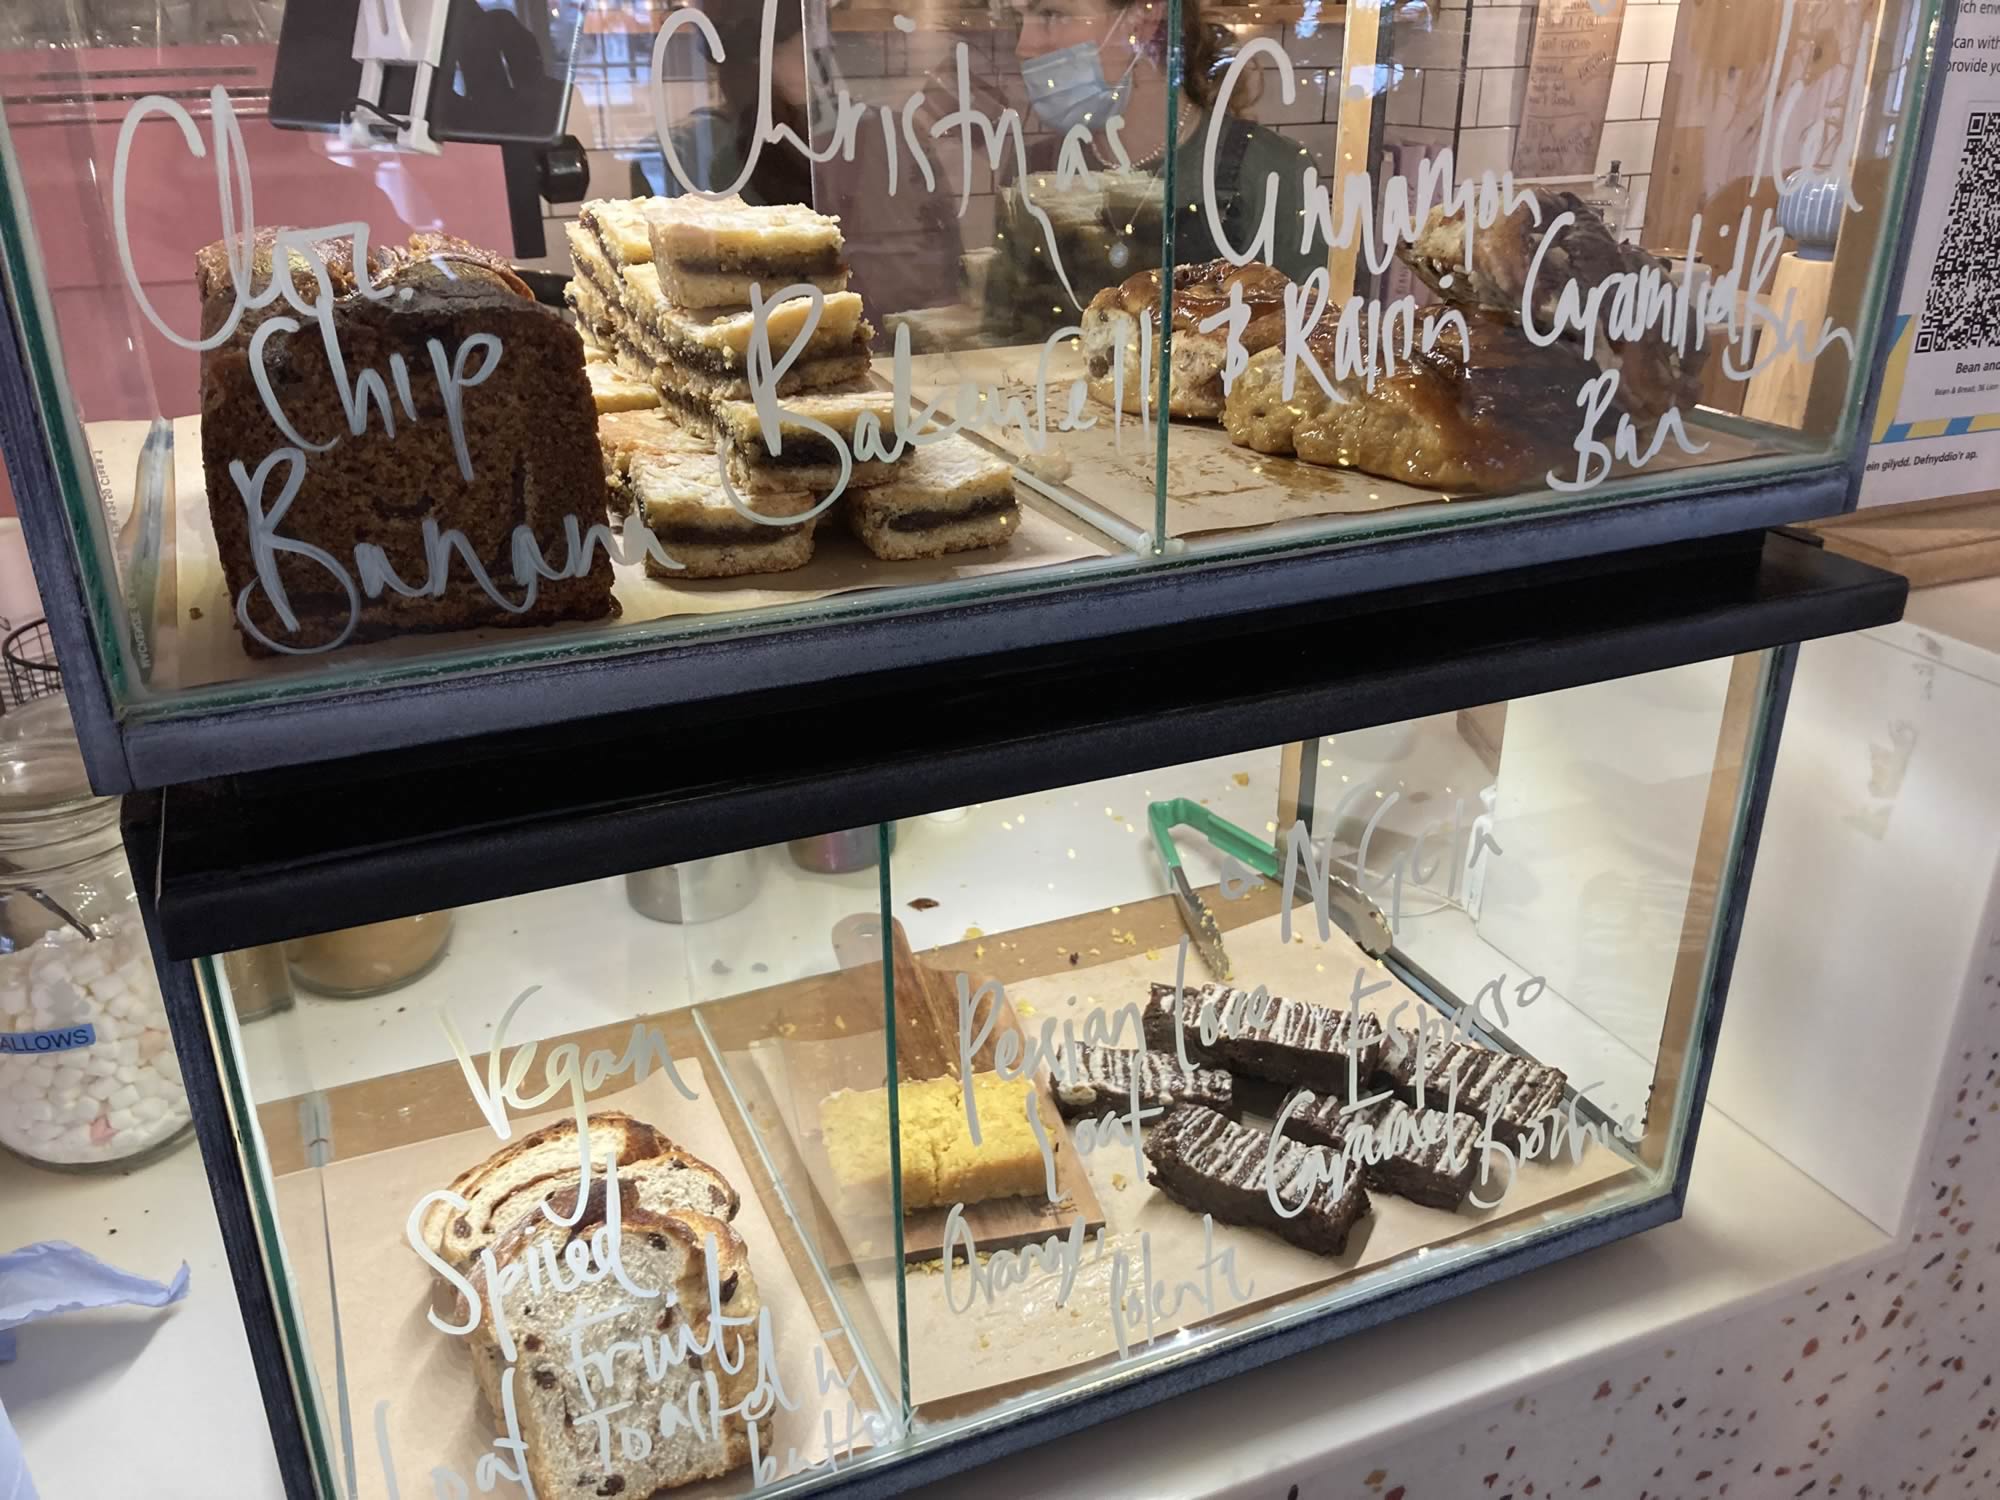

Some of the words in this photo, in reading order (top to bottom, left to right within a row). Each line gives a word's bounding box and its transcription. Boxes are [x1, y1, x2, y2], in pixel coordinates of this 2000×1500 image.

[1952, 37, 1974, 49] can
[1955, 362, 1981, 374] Bean
[437, 985, 699, 1227] Vegan
